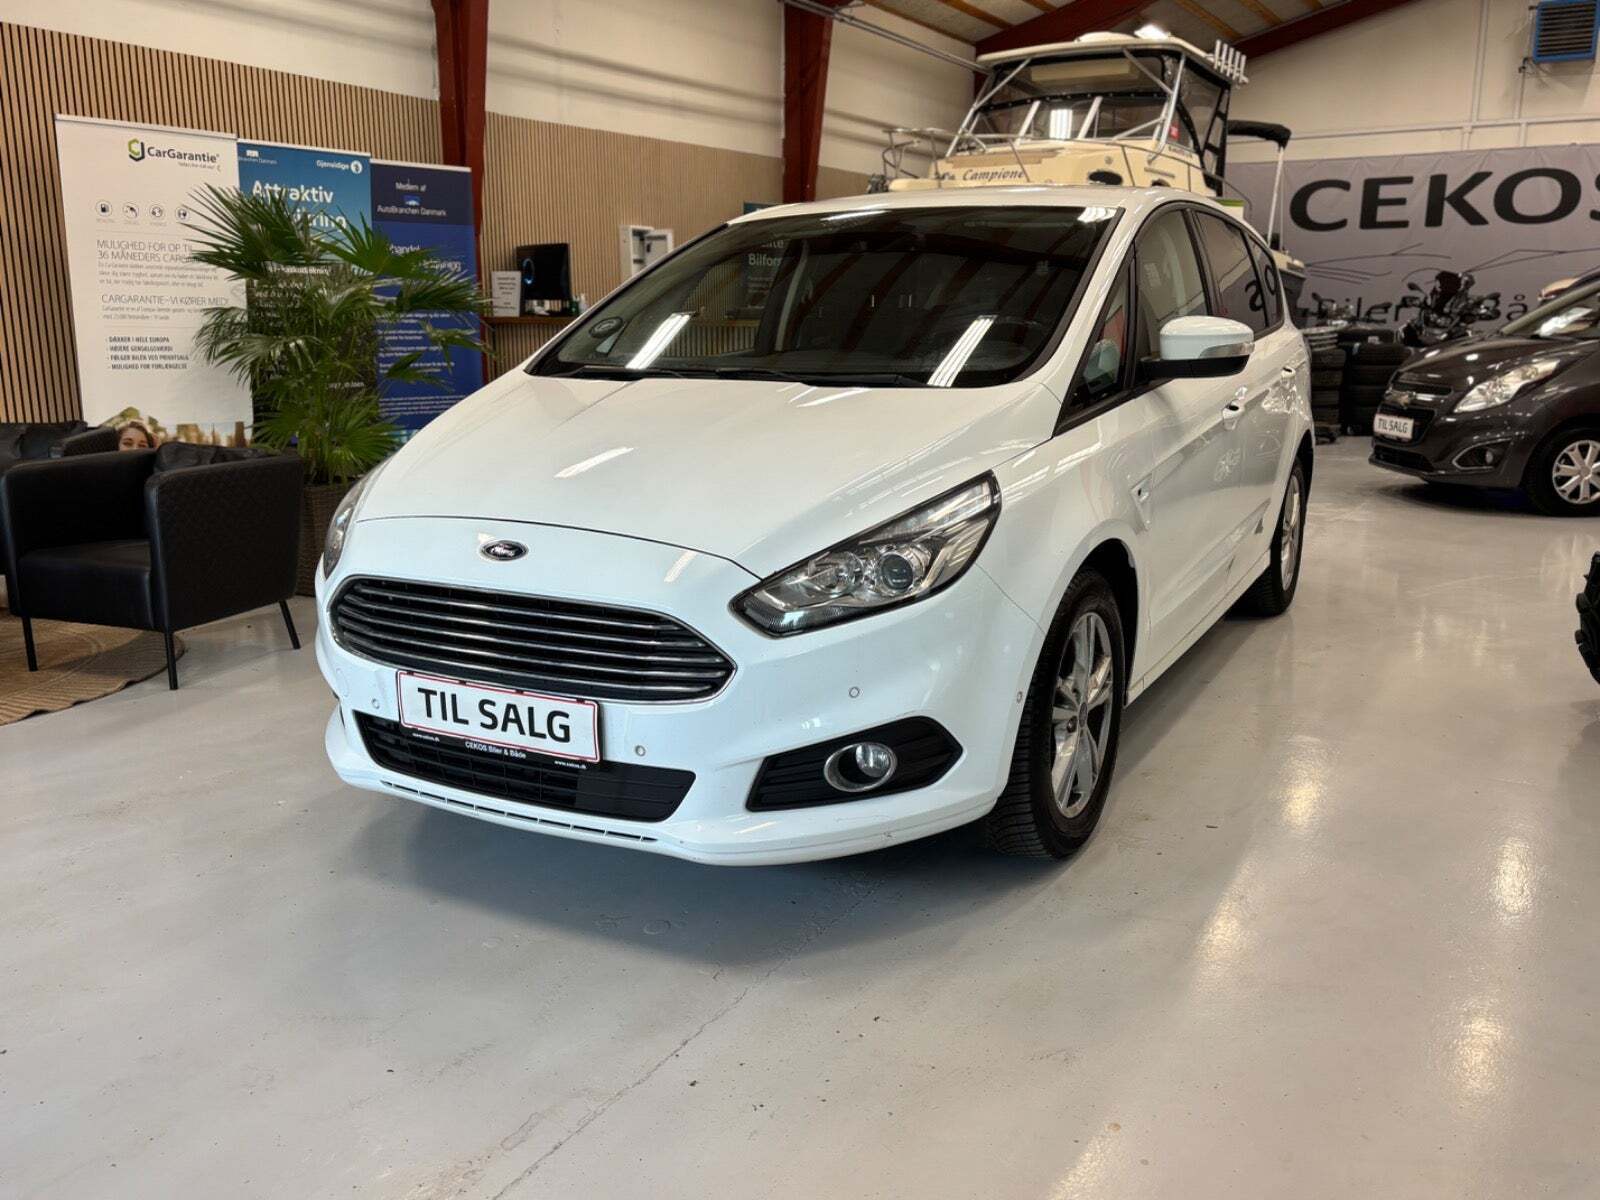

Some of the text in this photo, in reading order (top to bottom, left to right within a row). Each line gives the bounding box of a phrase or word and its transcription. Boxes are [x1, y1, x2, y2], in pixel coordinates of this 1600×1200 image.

[147, 146, 217, 163] CarGarantie
[962, 167, 1025, 182] Campione
[1289, 167, 1600, 232] CEKO
[96, 239, 146, 251] MULIGHED
[148, 241, 166, 252] FOR
[168, 242, 181, 252] OP
[111, 249, 160, 262] MÅNEDERS
[101, 294, 165, 305] CARGARANTIE
[1389, 420, 1409, 434] SALG
[417, 687, 571, 743] TIL SALG
[464, 741, 488, 752] CEKOS
[488, 746, 502, 754] Biler
